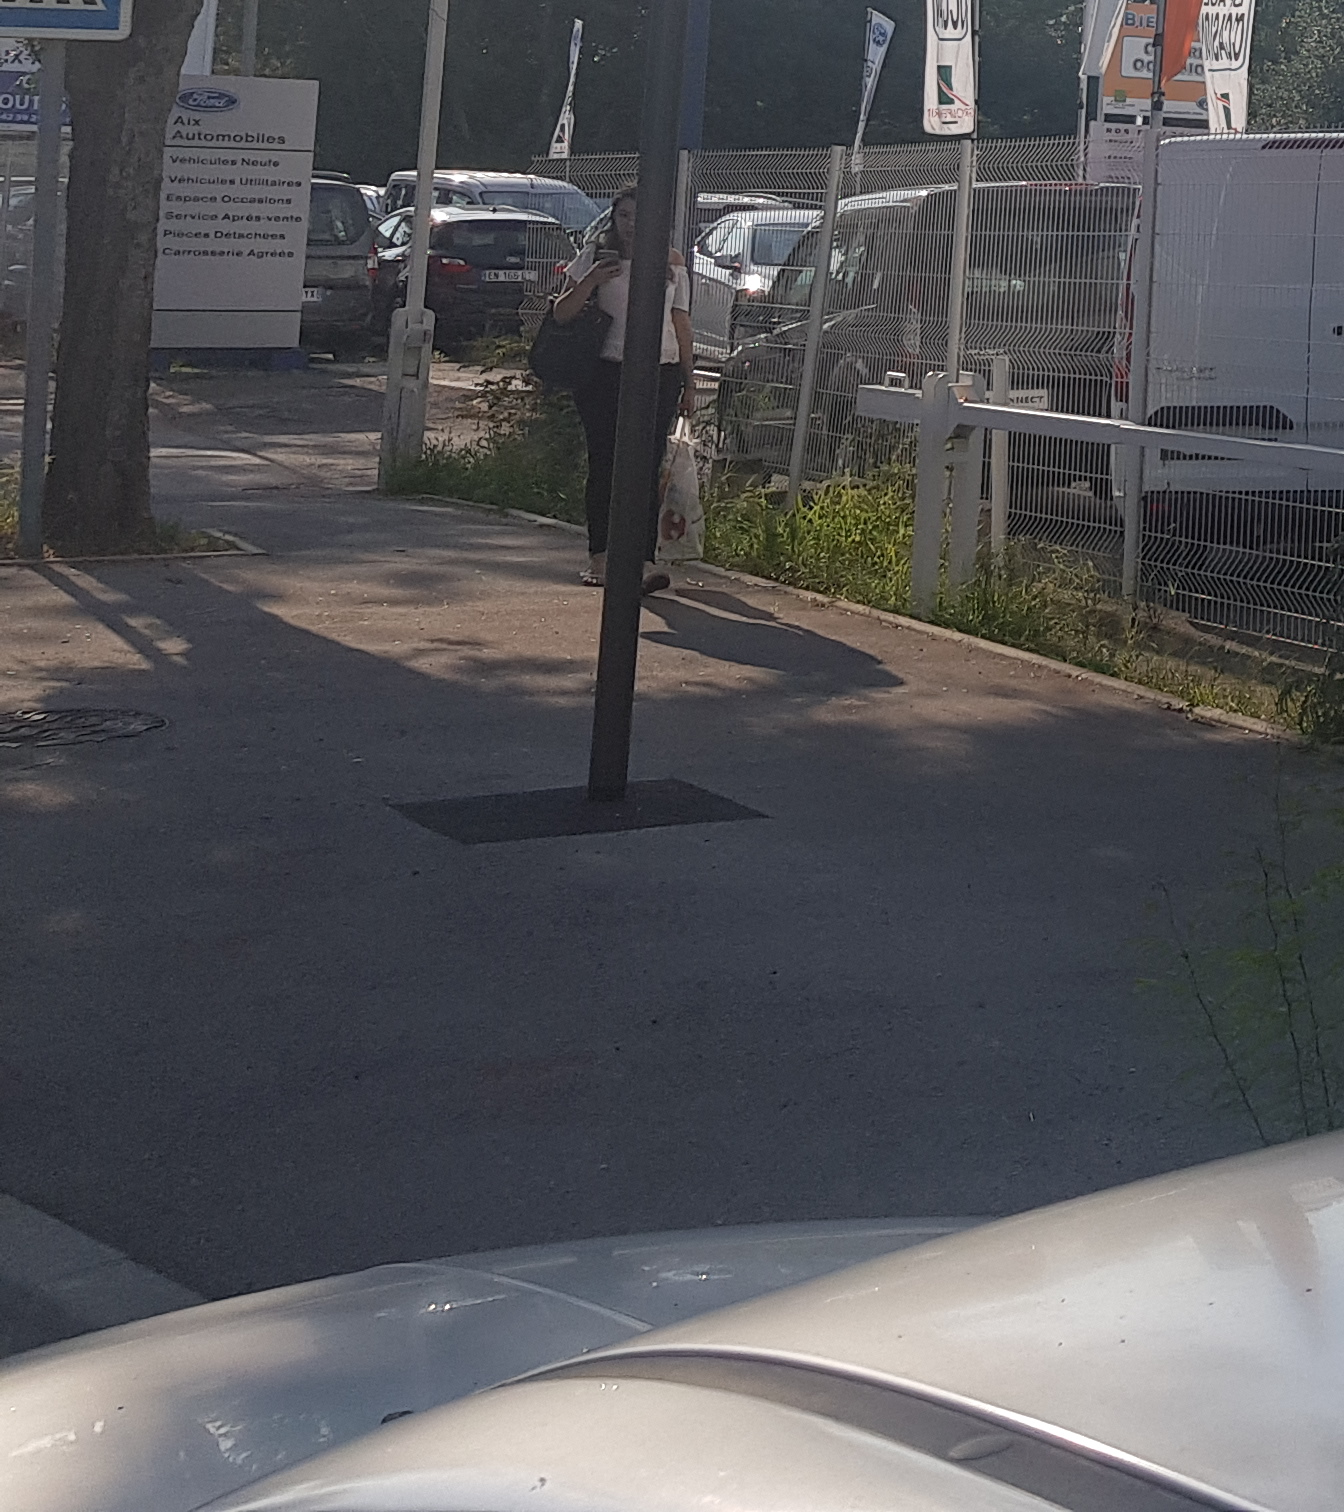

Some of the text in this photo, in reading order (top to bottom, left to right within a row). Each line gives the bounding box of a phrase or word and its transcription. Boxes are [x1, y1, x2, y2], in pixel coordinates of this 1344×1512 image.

[173, 115, 202, 127] Aix
[172, 130, 286, 145] Automobiles
[169, 155, 238, 166] Véhicules
[168, 175, 303, 188] Véhicules Utilitaires
[166, 193, 292, 205] Espace Occasions
[165, 211, 219, 221] Service
[162, 247, 244, 258] Carrosserie
